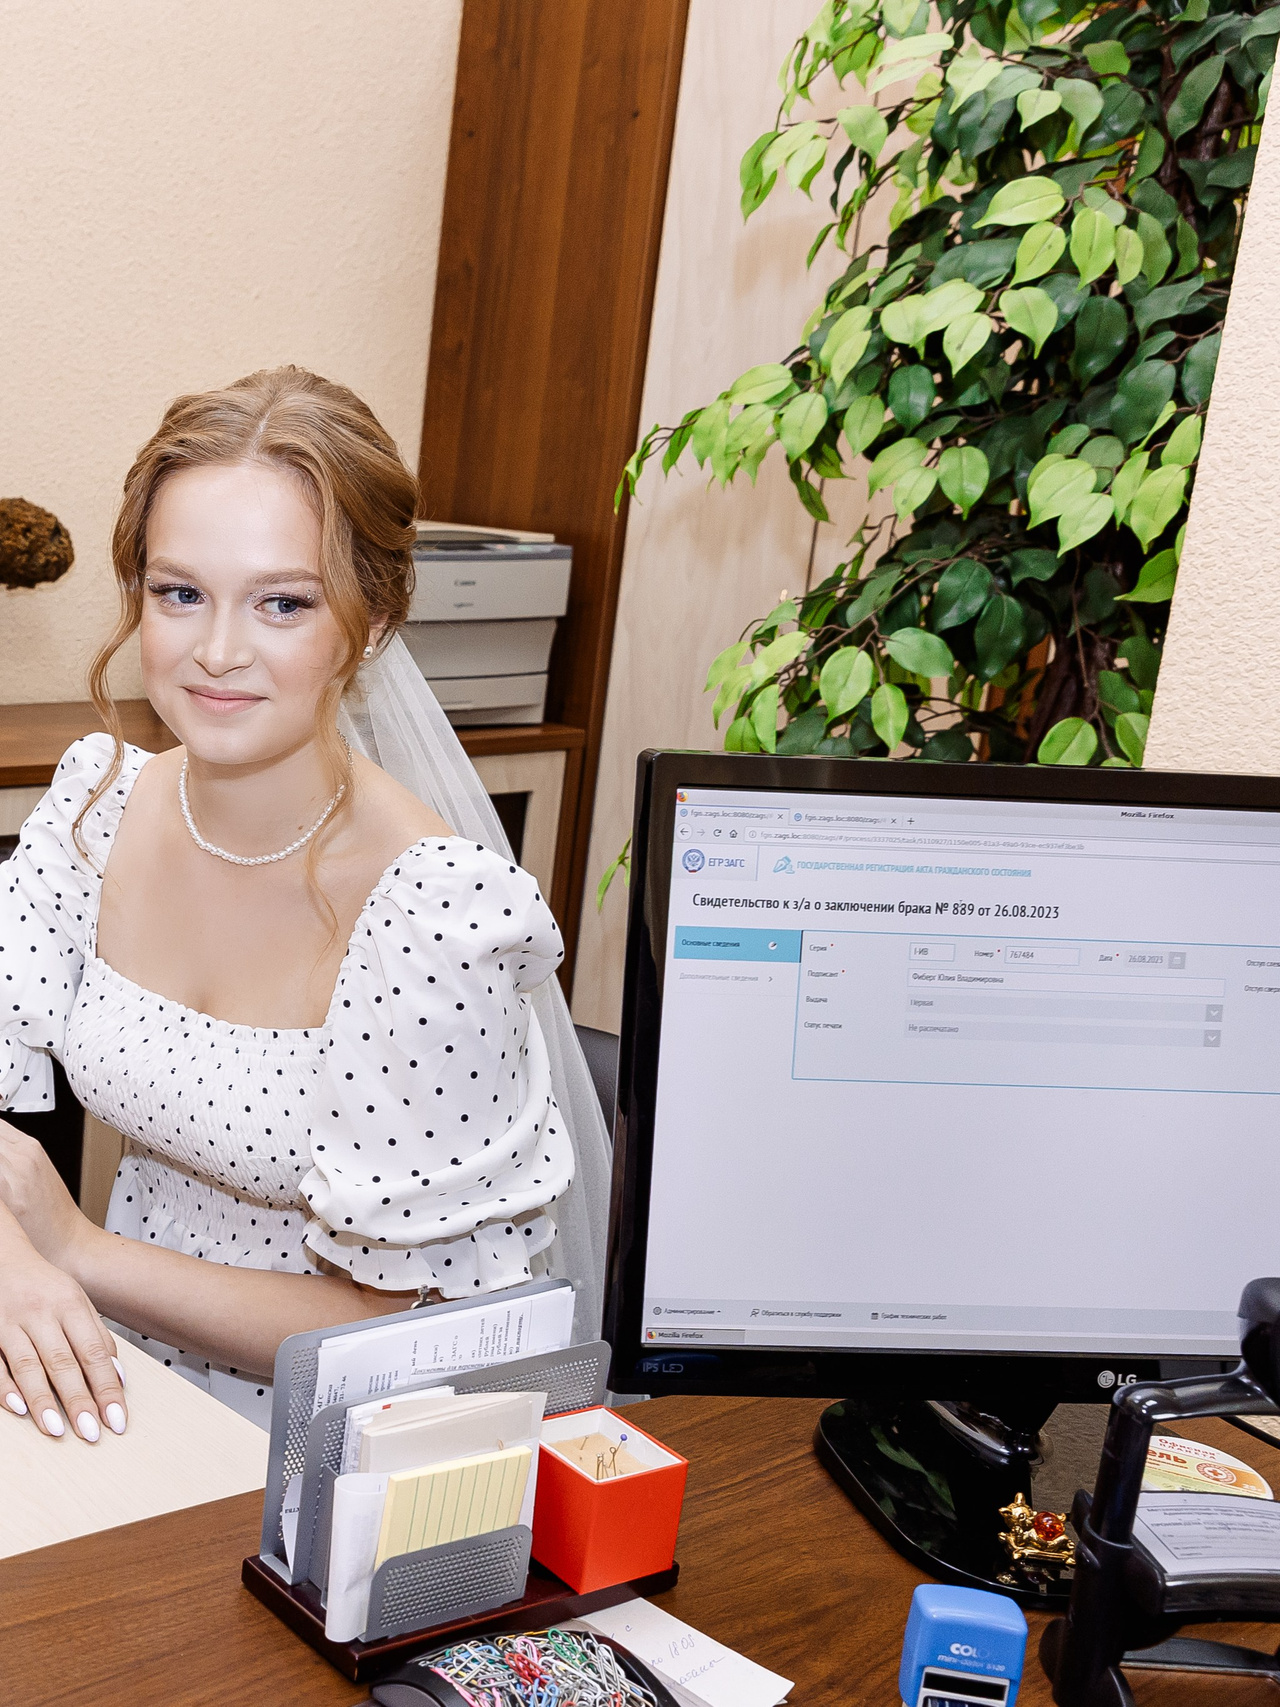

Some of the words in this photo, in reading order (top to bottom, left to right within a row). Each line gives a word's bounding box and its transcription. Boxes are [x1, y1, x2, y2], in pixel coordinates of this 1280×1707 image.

[708, 857, 724, 867] ЕГР
[724, 857, 745, 868] ЗАГС
[797, 861, 864, 871] ГОСУДАРСТВЕННАЯ
[865, 863, 915, 873] РЕГИСТРАЦИЯ
[916, 865, 933, 873] АКТА
[935, 866, 990, 876] ГРАЖДАНСКОГО
[991, 869, 1032, 878] СОСТОЯНИЯ
[692, 893, 779, 909] Свидетельство
[783, 900, 789, 909] к
[792, 898, 810, 912] з/а
[814, 901, 821, 910] о
[824, 901, 895, 913] заключении
[898, 901, 931, 916] брака
[935, 902, 949, 915] №
[952, 902, 974, 916] 889
[978, 907, 991, 916] от
[994, 904, 1059, 919] 26.08.2023
[681, 939, 712, 947] Основные
[1128, 954, 1163, 963] 26.08.2023
[908, 1024, 918, 1032] Не
[919, 1025, 959, 1033] распечатано
[642, 1362, 659, 1373] IPS
[662, 1363, 684, 1373] LED
[1117, 1373, 1137, 1386] LG
